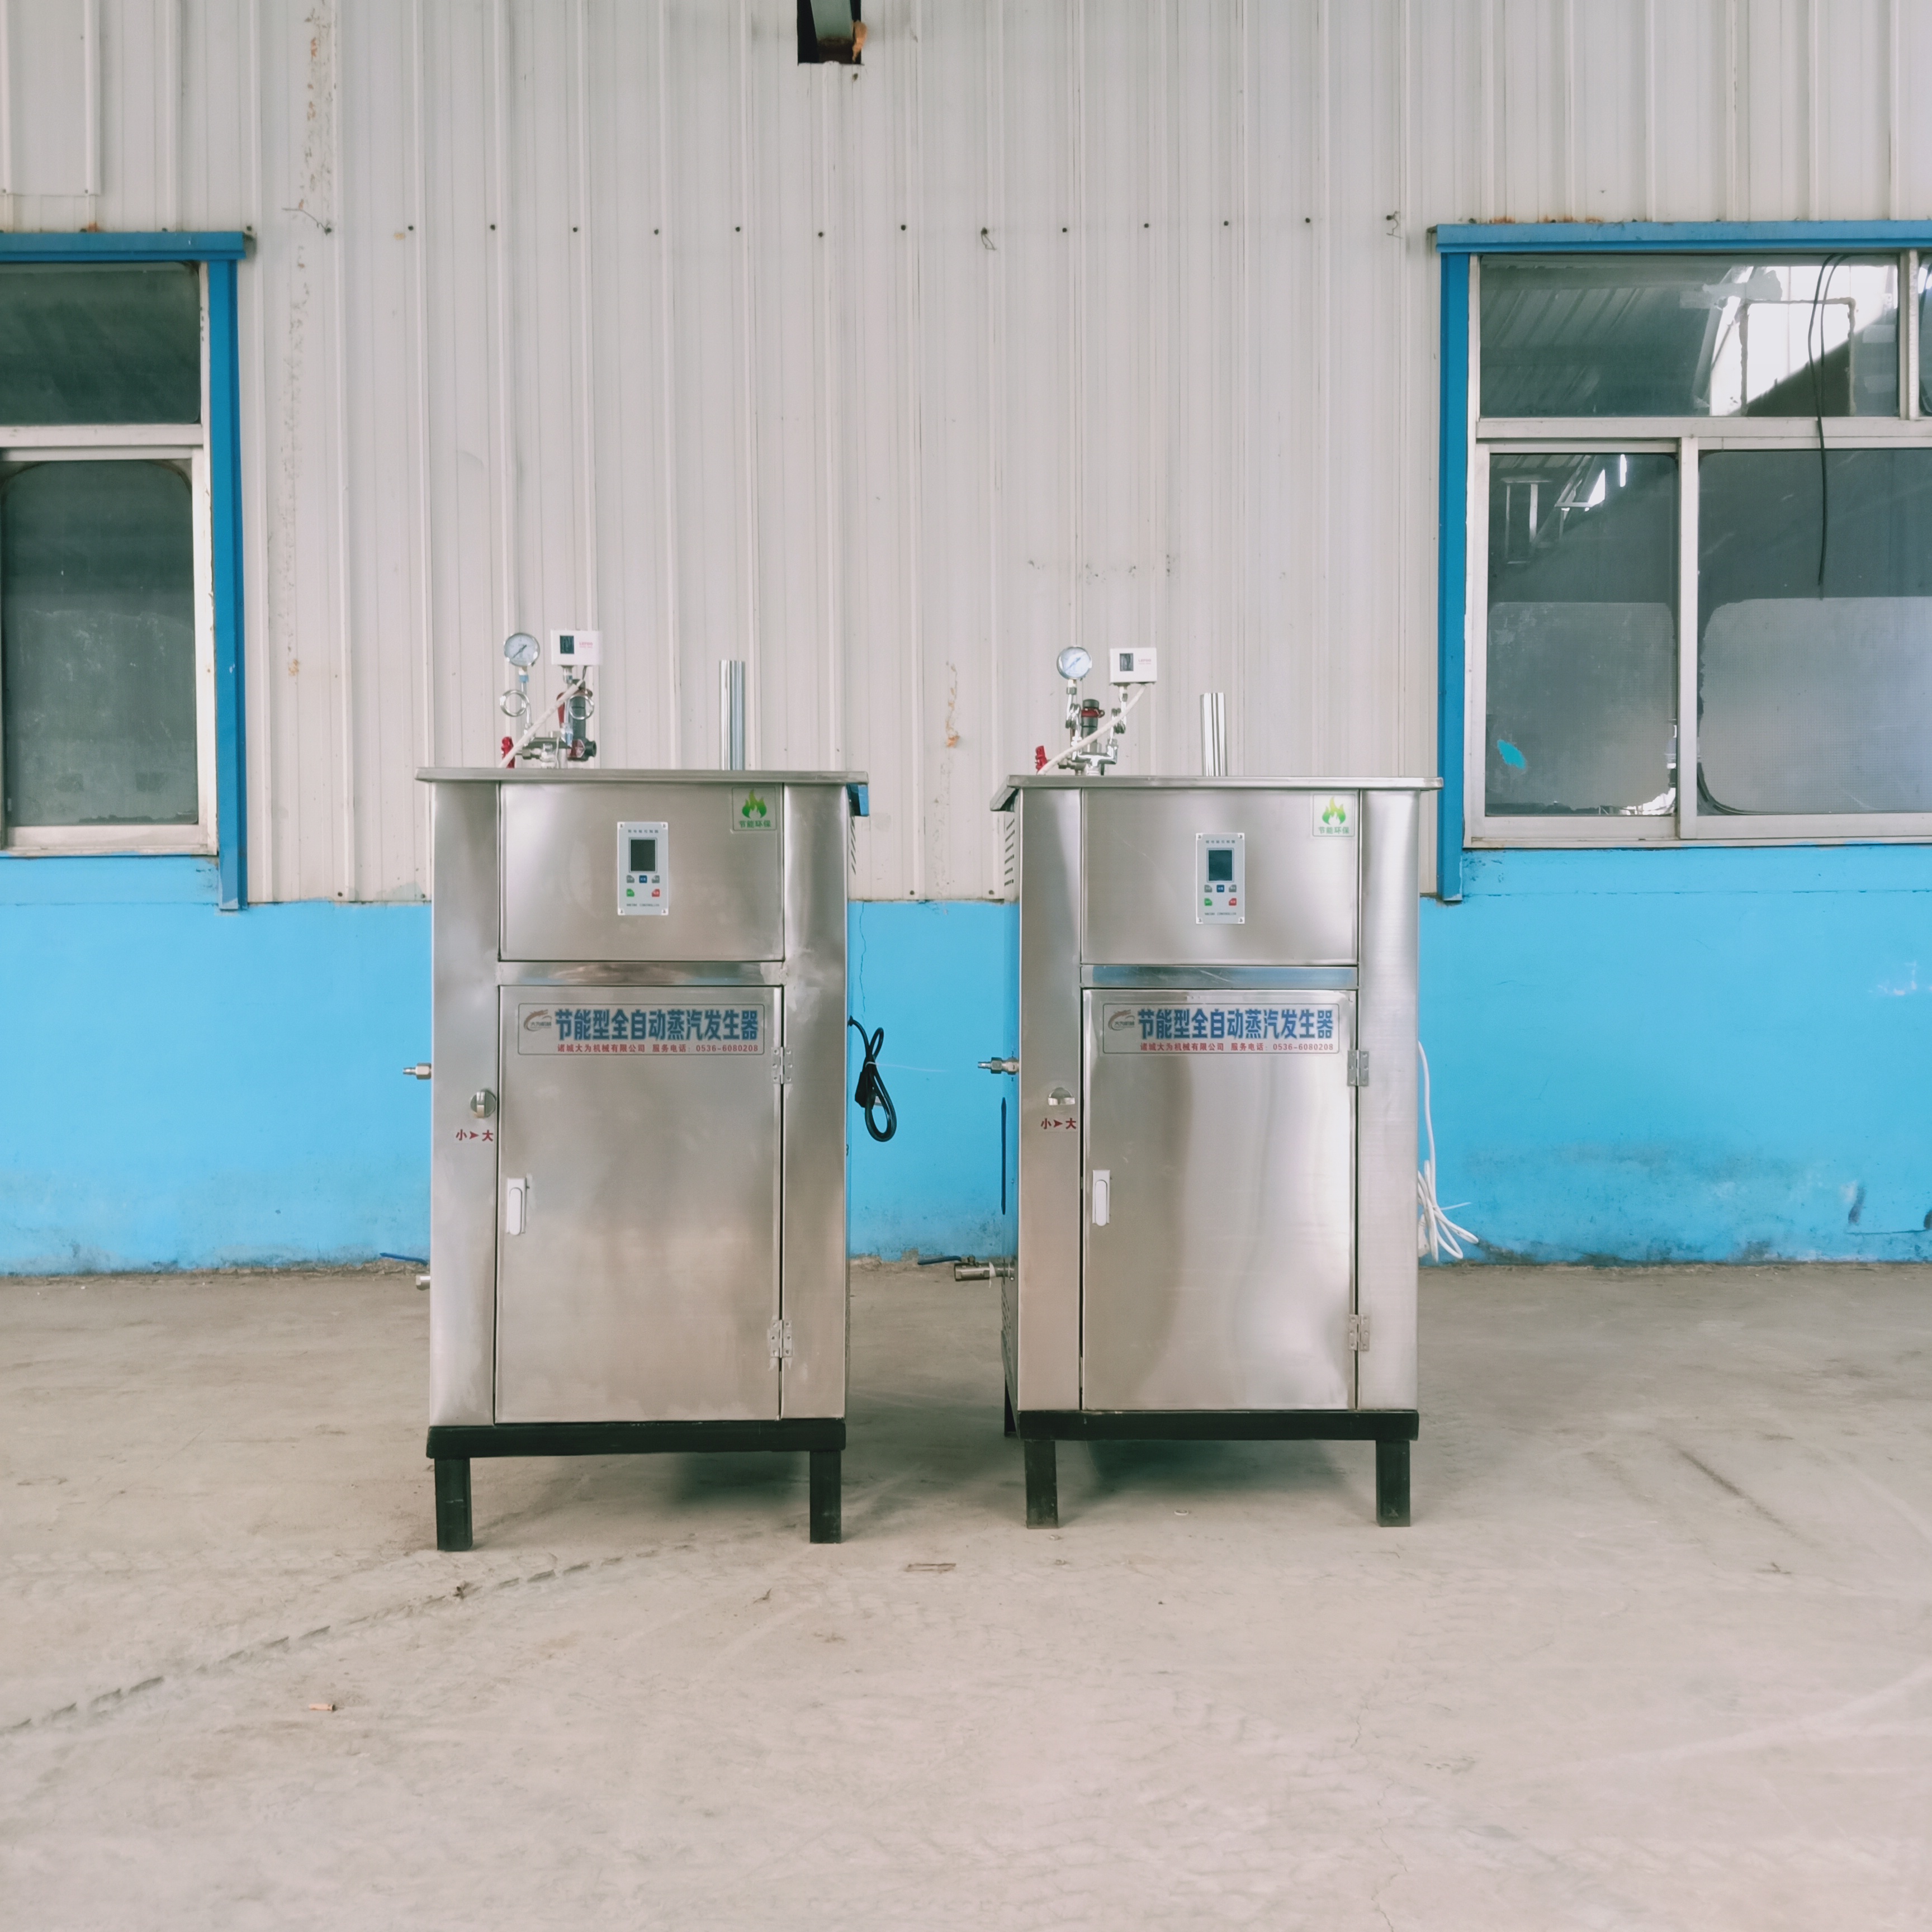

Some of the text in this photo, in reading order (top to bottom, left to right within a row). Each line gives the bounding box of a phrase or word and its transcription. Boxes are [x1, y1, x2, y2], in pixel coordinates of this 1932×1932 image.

[555, 1008, 759, 1041] 节能型全自动蒸汽发生器
[1138, 1008, 1334, 1039] 节能型全自动蒸汽发生器
[557, 1044, 646, 1053] 诸城大为机械有限公司
[1140, 1043, 1224, 1052] 诸城大为机械有限公司
[1041, 1117, 1077, 1130] 小 大
[456, 1129, 494, 1142] 小 大
